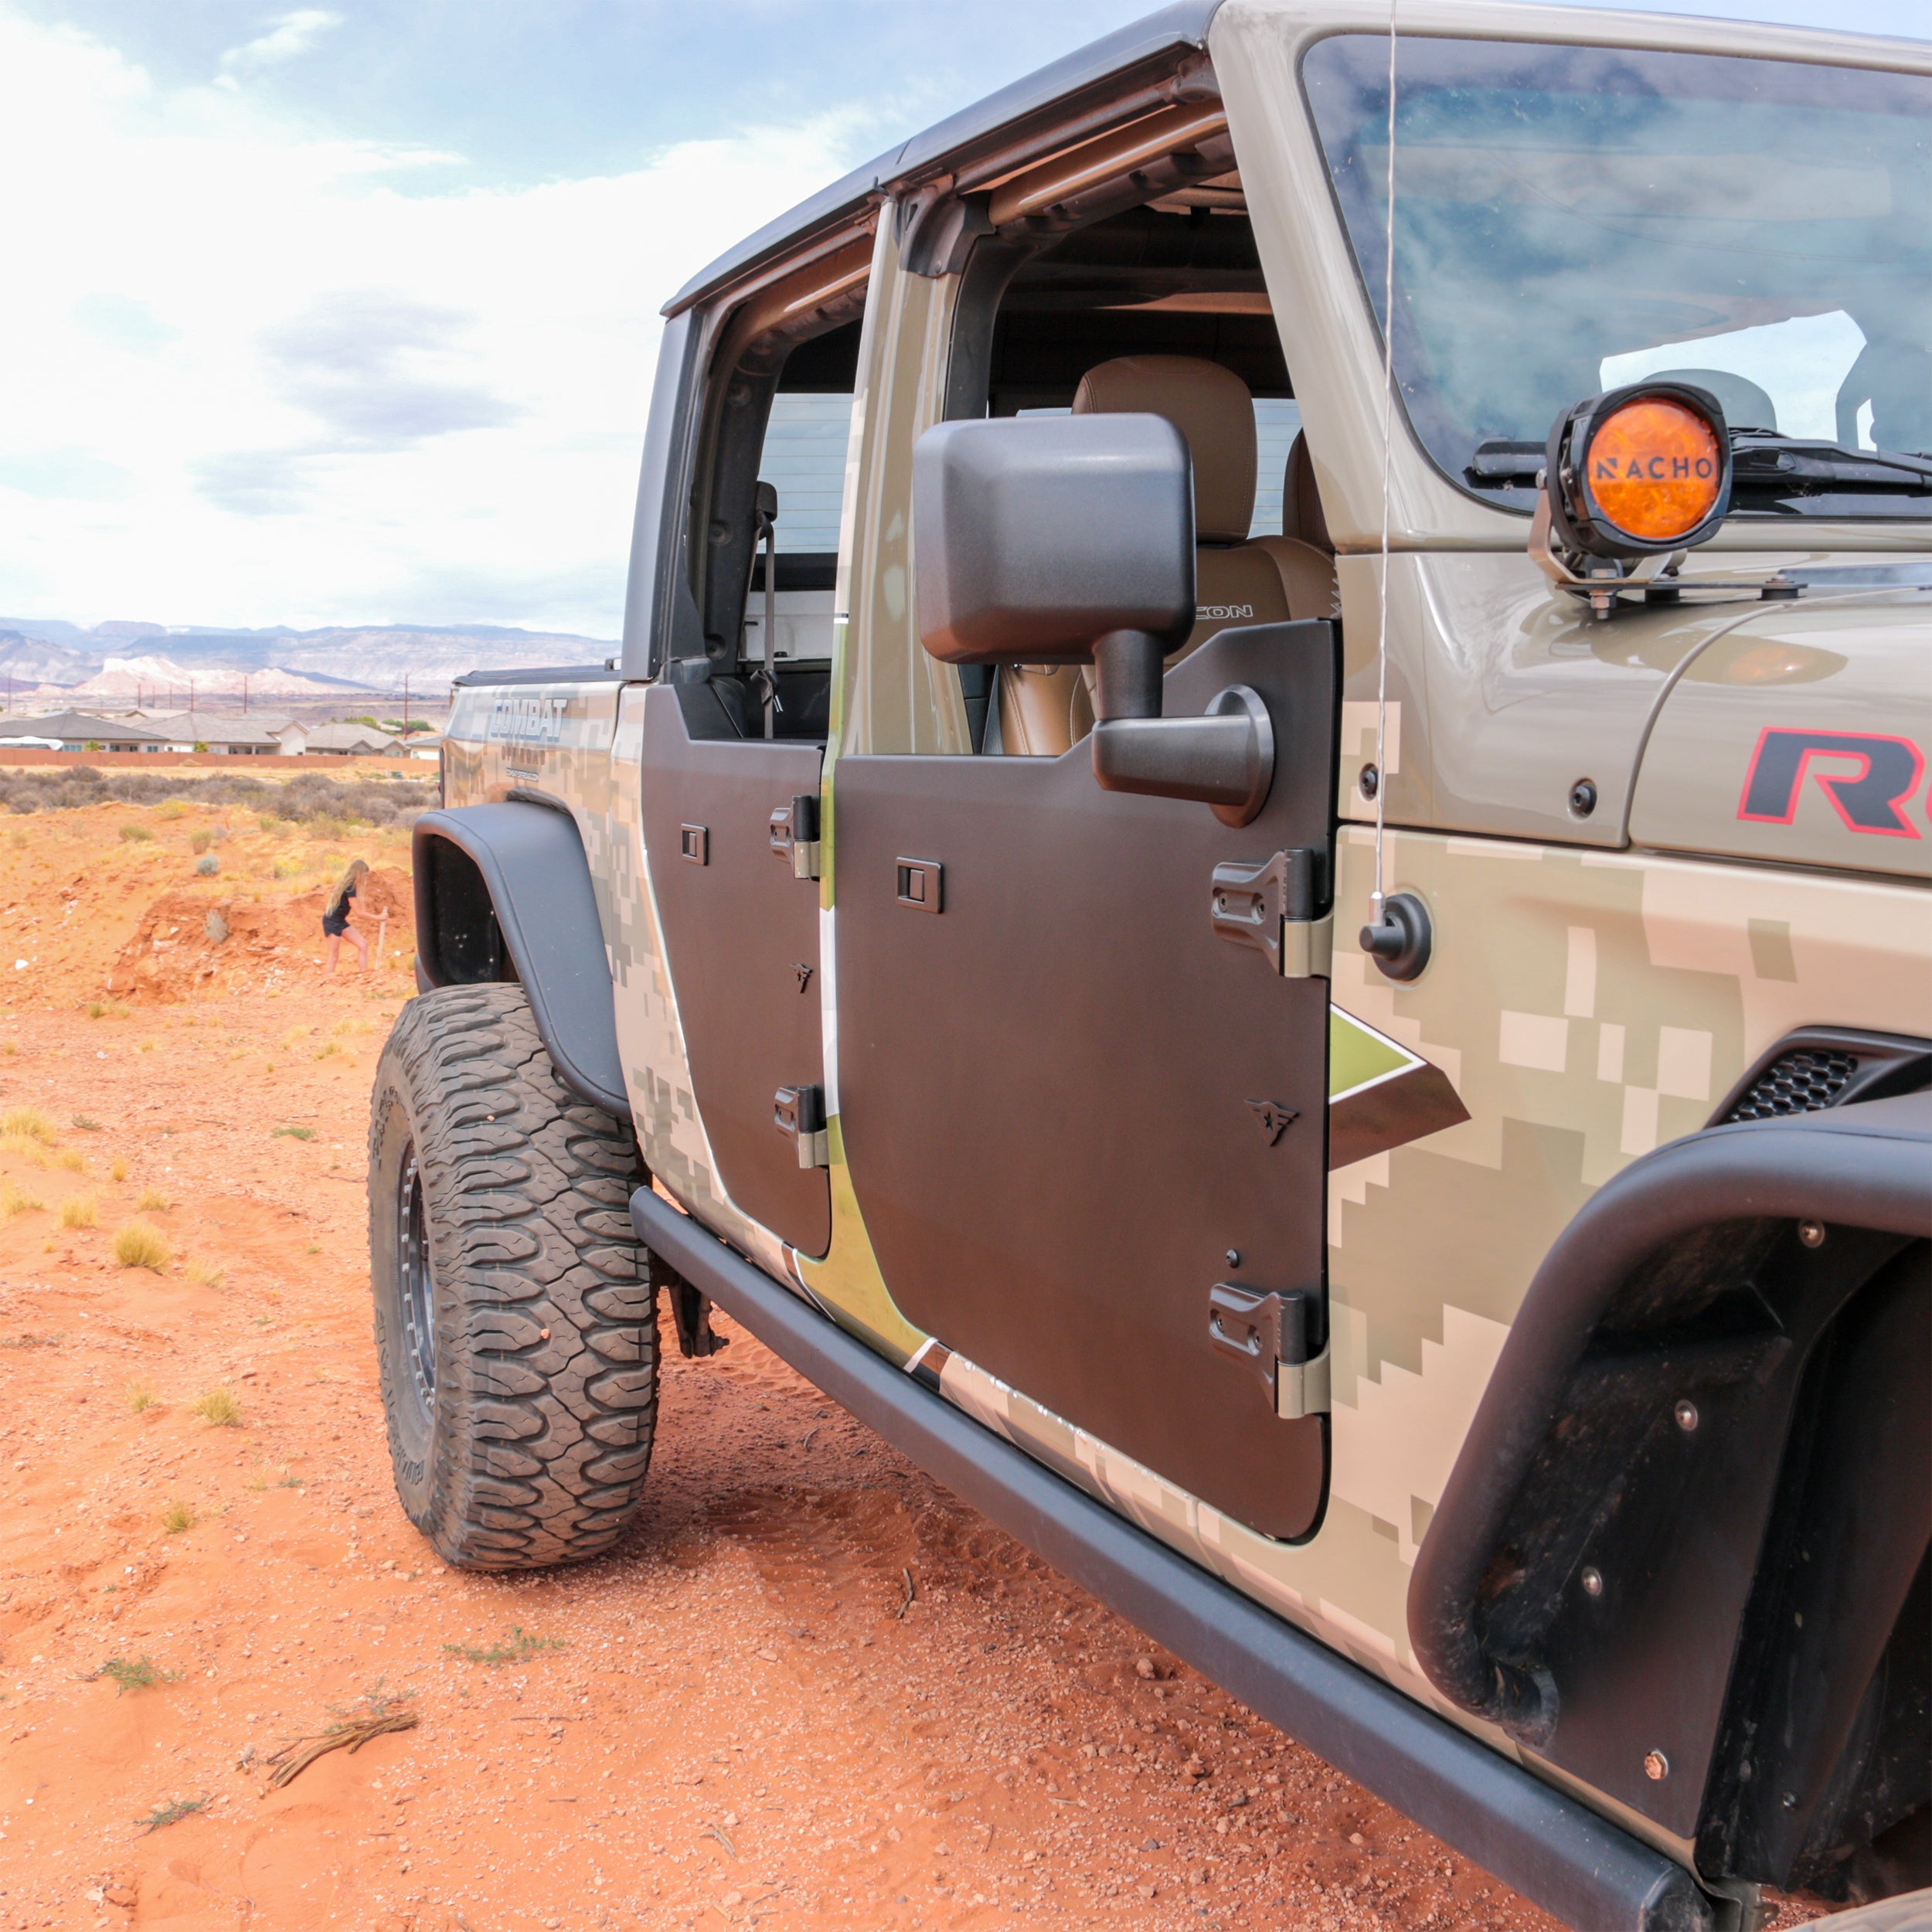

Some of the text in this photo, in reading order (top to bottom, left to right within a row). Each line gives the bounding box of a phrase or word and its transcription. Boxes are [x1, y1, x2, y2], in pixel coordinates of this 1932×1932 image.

[1597, 456, 1713, 480] NACHO
[490, 698, 568, 742] COMBAT
[1736, 726, 1932, 840] R
